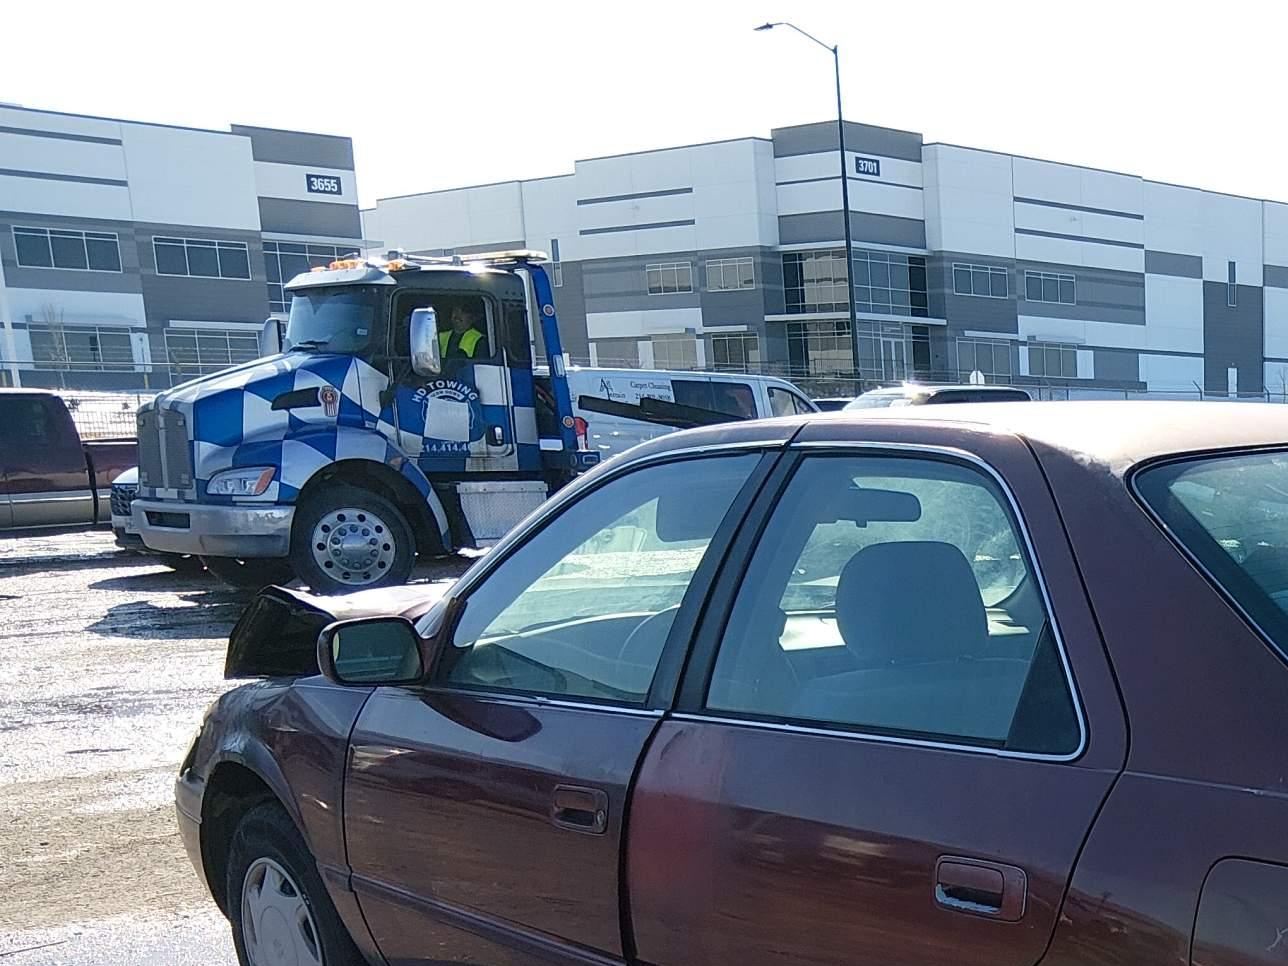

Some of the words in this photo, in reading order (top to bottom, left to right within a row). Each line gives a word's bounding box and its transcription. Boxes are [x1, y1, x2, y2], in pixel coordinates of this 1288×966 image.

[858, 160, 878, 174] 3701
[310, 177, 338, 192] 3655
[411, 387, 427, 403] HD
[426, 379, 479, 401] TOWING
